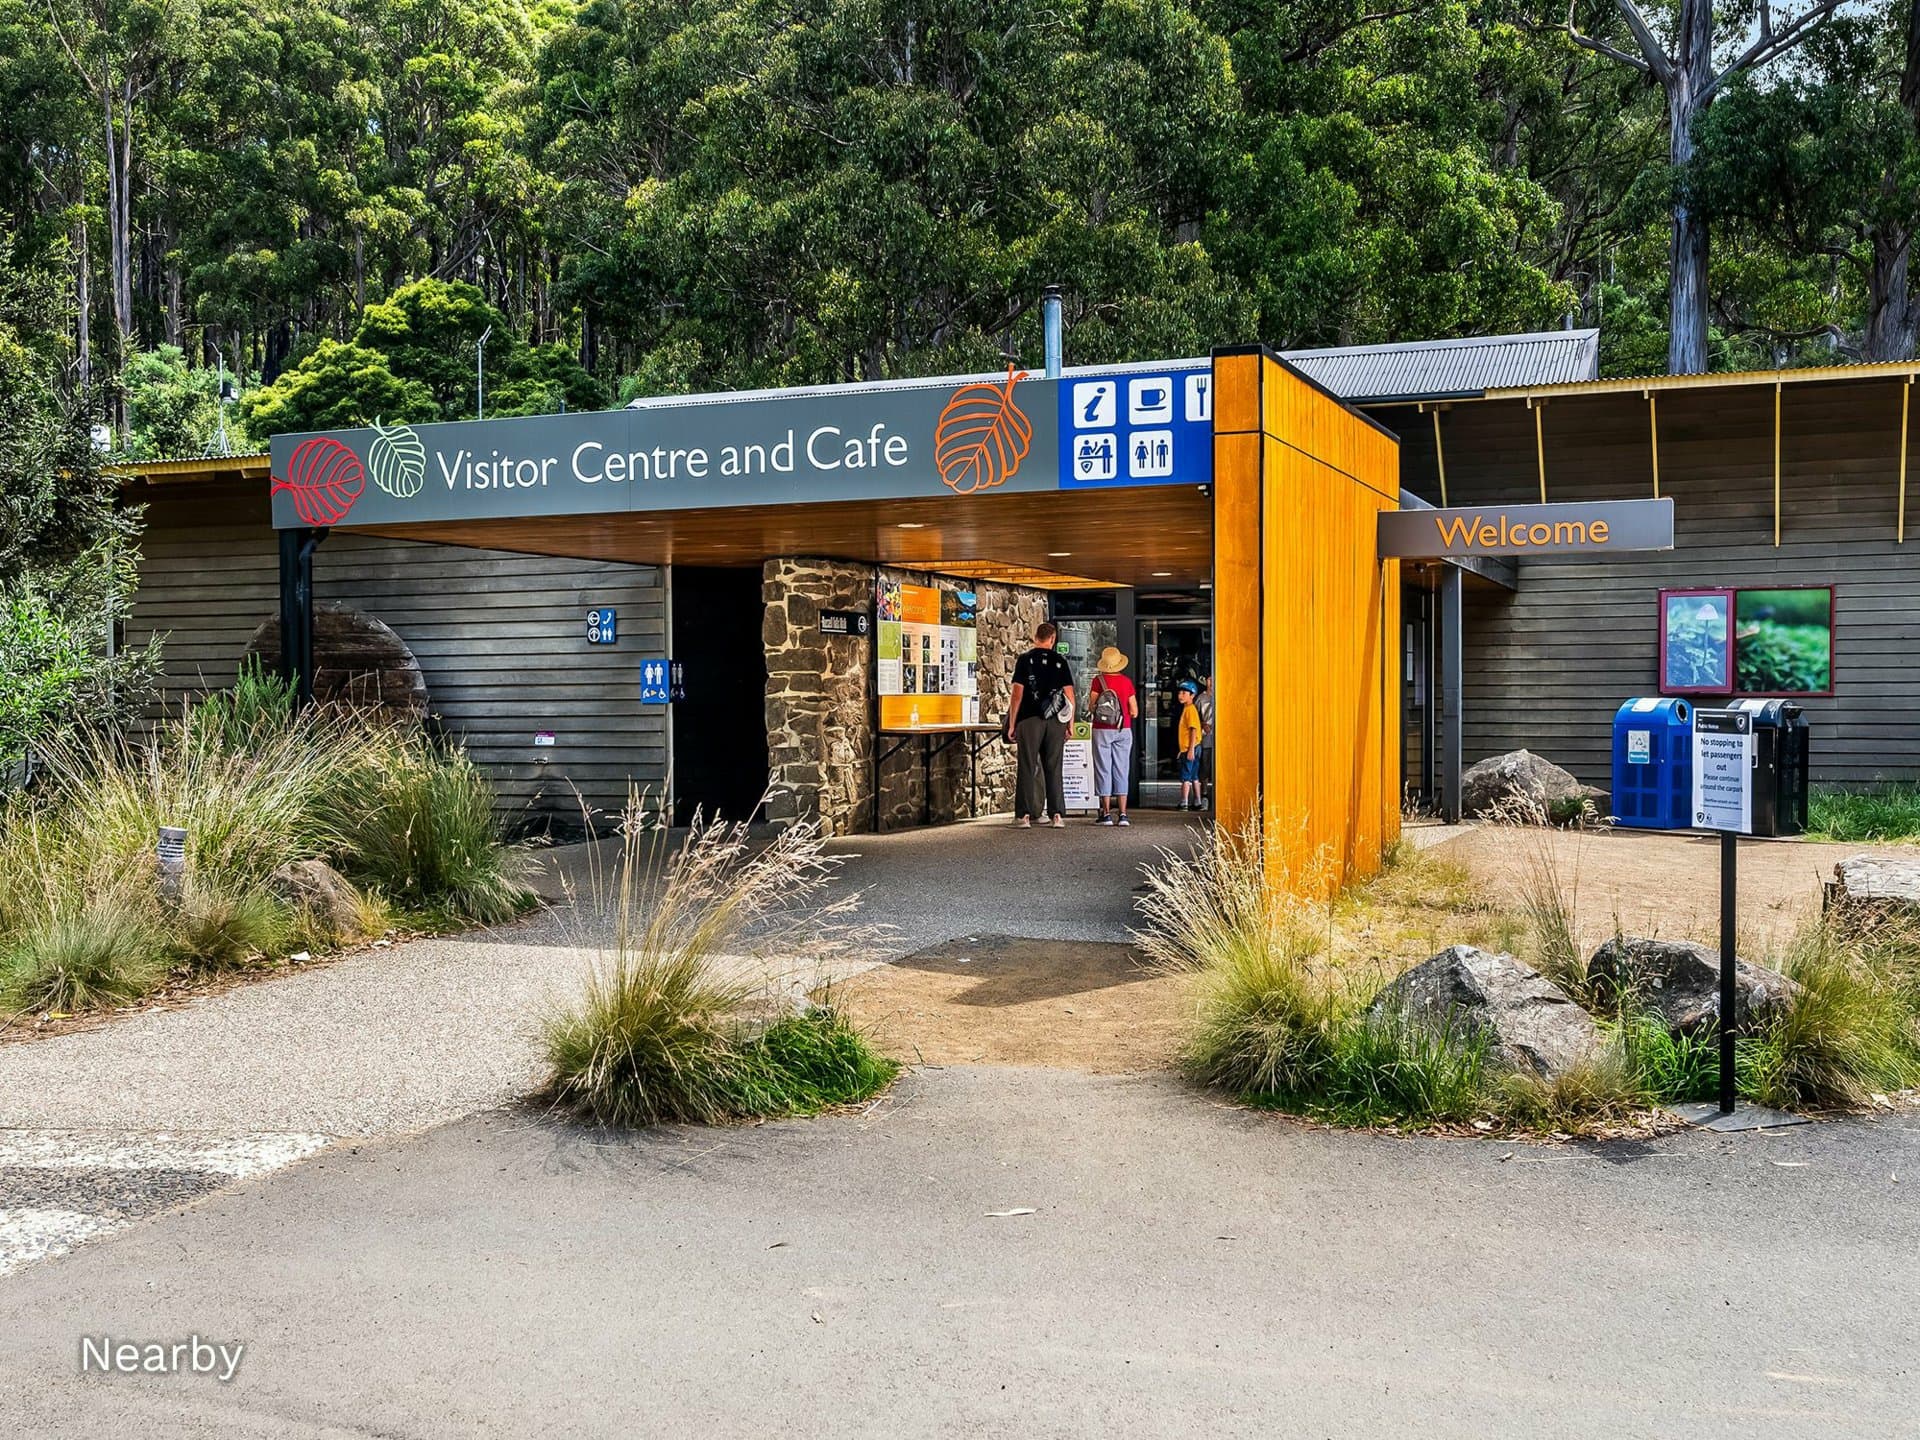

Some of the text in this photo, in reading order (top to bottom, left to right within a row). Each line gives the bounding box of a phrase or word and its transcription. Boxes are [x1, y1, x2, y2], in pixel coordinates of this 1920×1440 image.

[436, 423, 908, 490] Visitor Centre and Cafe
[1435, 515, 1609, 548] Welcome
[1700, 738, 1743, 748] No stopping to
[1701, 750, 1743, 761] let passengers
